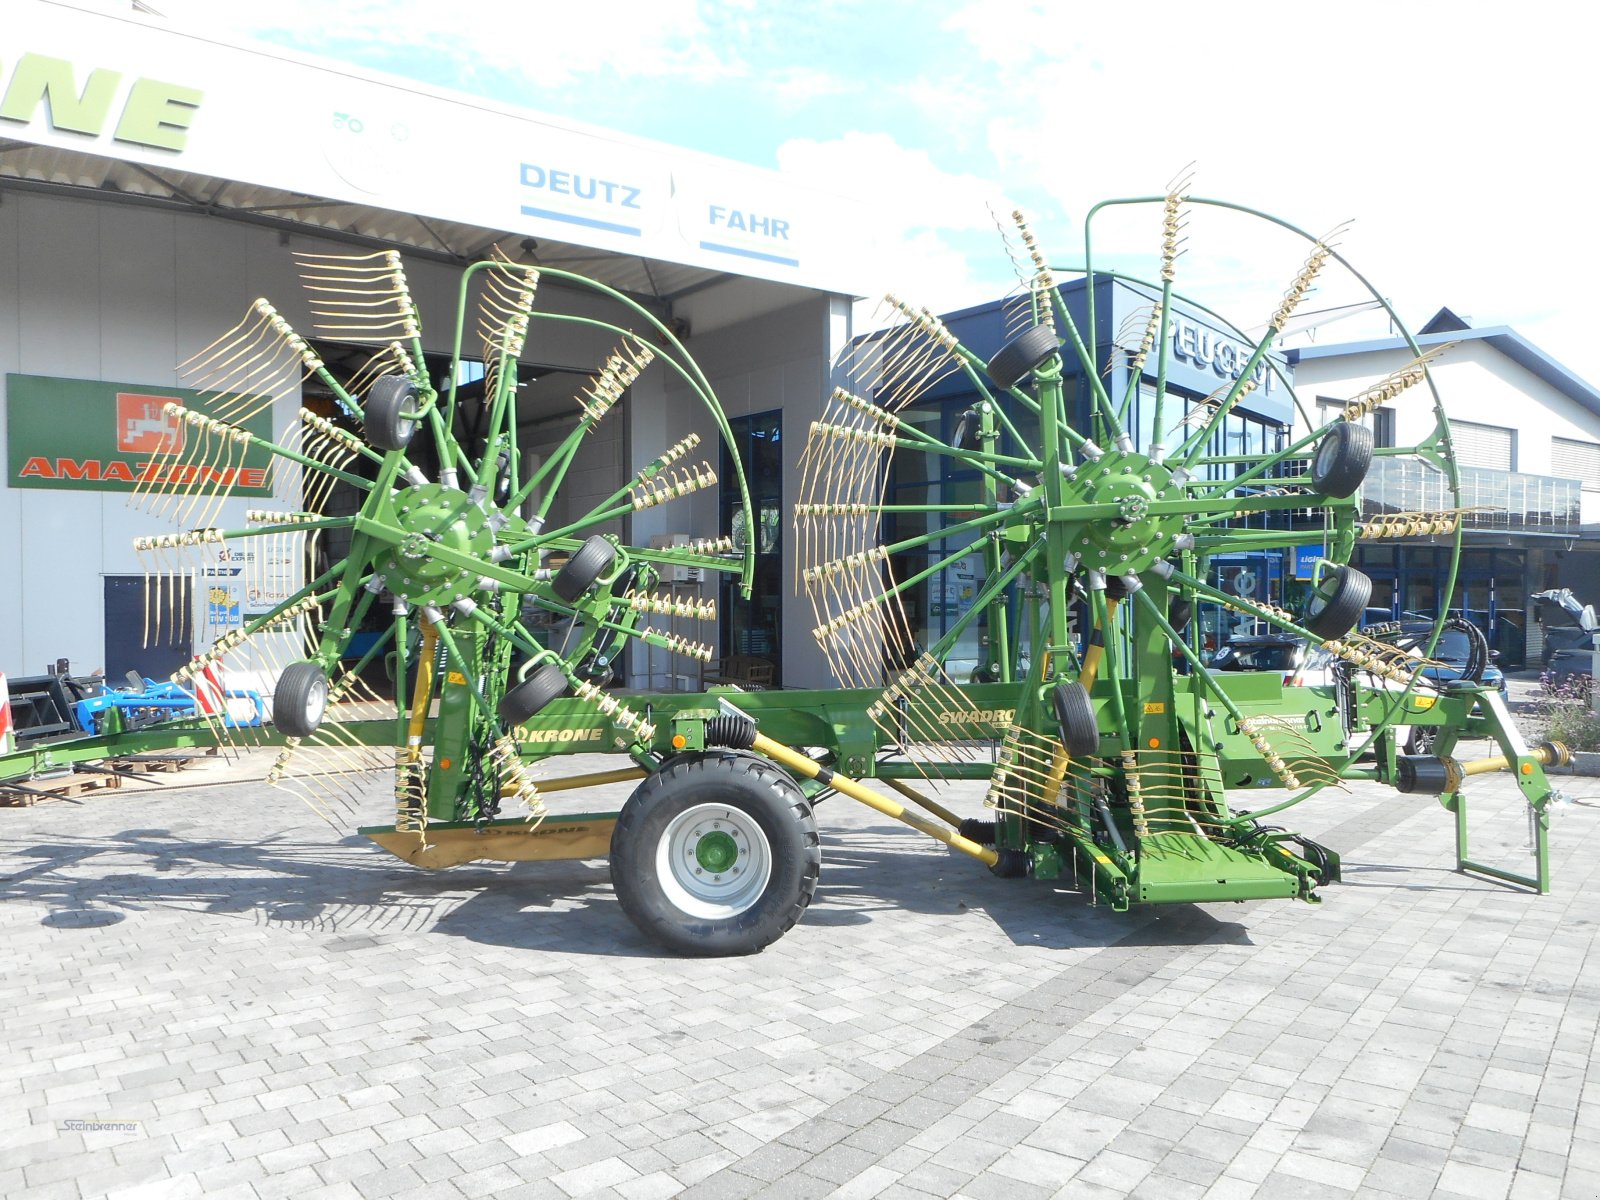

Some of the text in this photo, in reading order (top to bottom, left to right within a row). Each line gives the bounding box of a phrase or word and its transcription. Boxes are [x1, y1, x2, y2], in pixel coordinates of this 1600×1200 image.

[0, 52, 205, 154] NE
[519, 162, 790, 240] DEUTZ FAHR
[18, 456, 267, 488] AMAZONE
[938, 709, 1017, 725] SWADRO
[529, 729, 604, 743] KRONE
